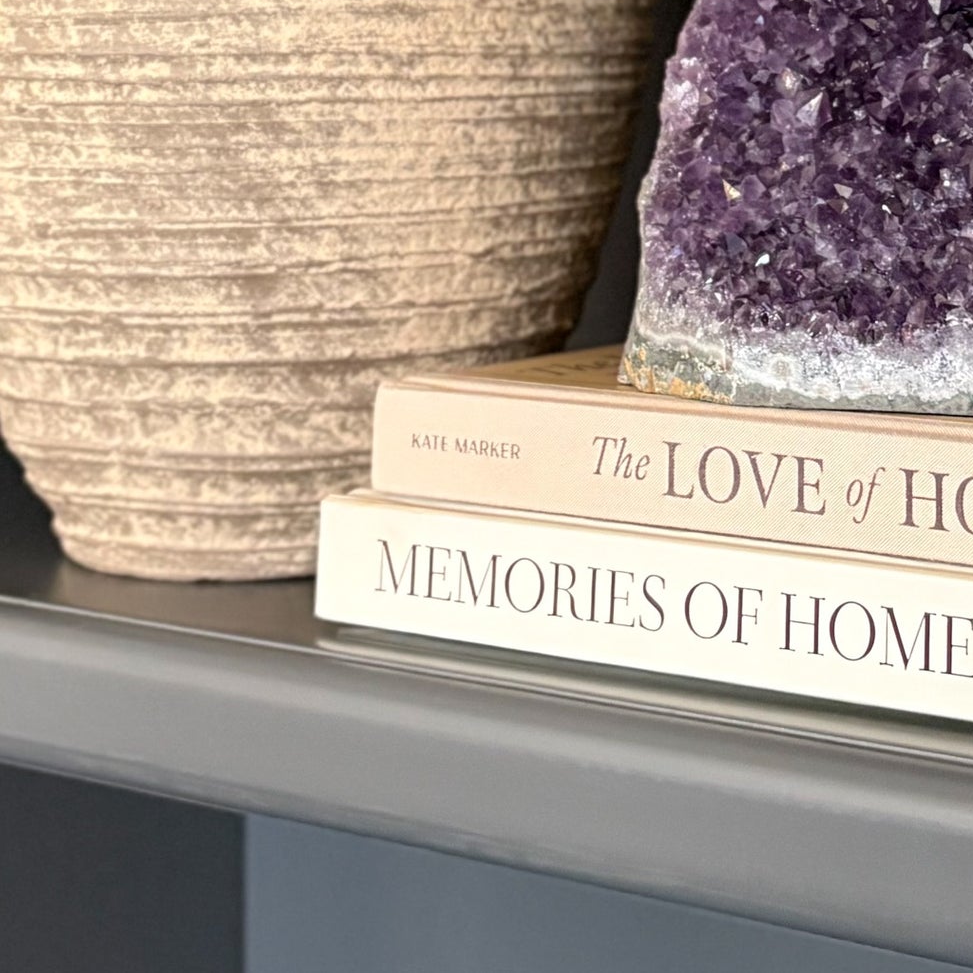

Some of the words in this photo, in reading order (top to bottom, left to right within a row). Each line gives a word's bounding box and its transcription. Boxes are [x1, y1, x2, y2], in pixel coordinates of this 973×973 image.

[411, 433, 448, 452] KATE
[454, 437, 521, 460] MARKER
[592, 436, 650, 480] The
[663, 441, 826, 516] LOVE
[846, 467, 885, 524] of
[375, 540, 666, 632] MEMORIES
[684, 582, 763, 645] OF
